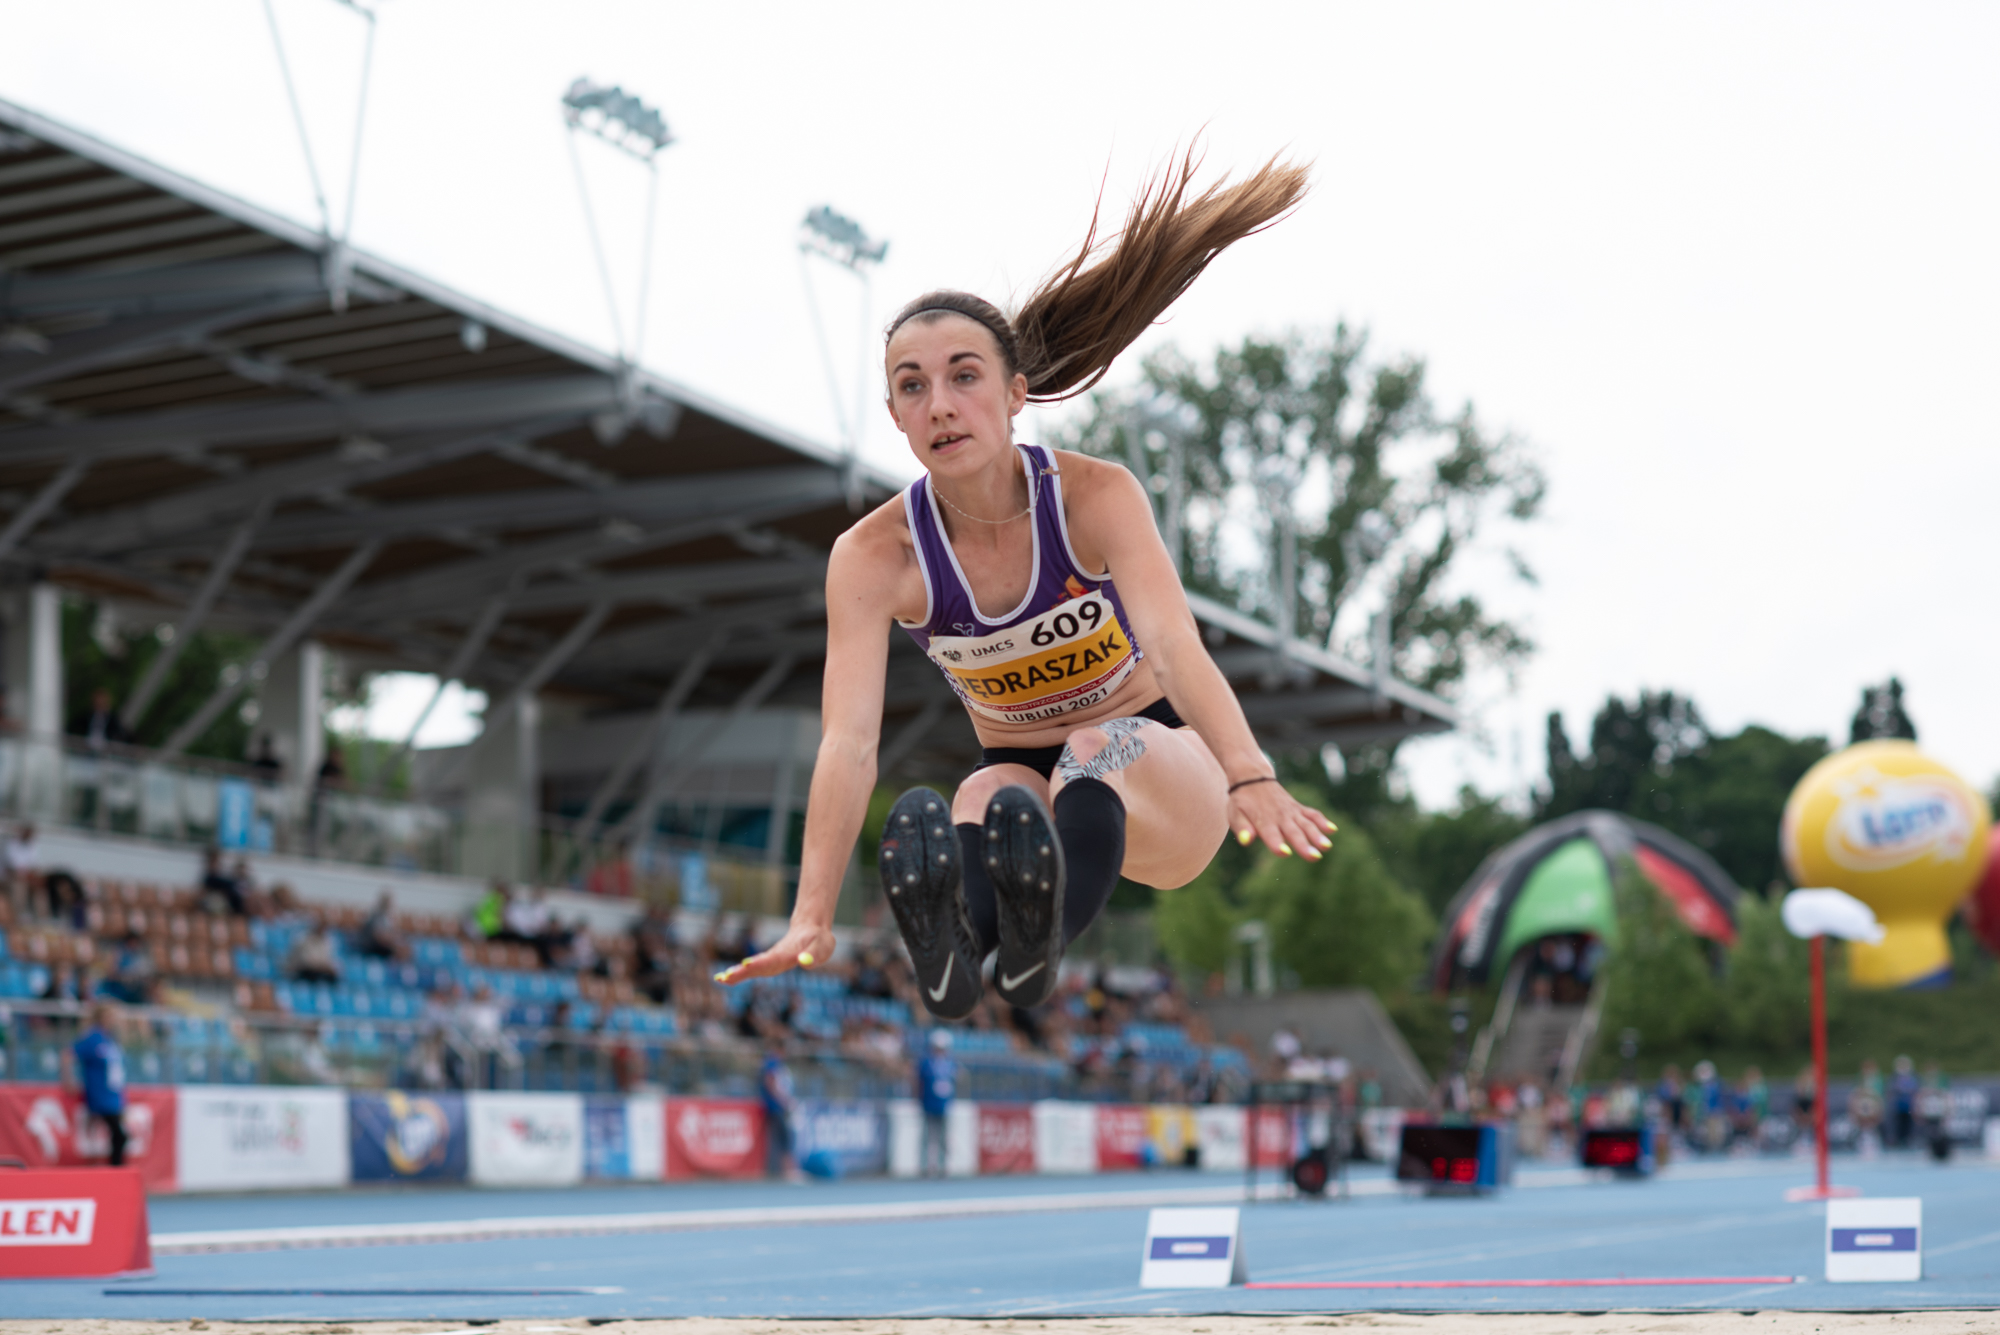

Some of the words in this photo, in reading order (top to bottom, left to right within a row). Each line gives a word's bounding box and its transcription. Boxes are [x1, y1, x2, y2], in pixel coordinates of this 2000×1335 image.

[1030, 600, 1102, 647] 609
[957, 632, 1122, 698] JĘDRASZAK
[971, 639, 1015, 657] UMCS
[1004, 705, 1063, 722] LUBLIN
[1068, 687, 1108, 711] 2021
[1010, 690, 1080, 711] MISTRZOSTWA
[1080, 673, 1112, 692] POLSKI
[0, 1210, 80, 1236] LEN
